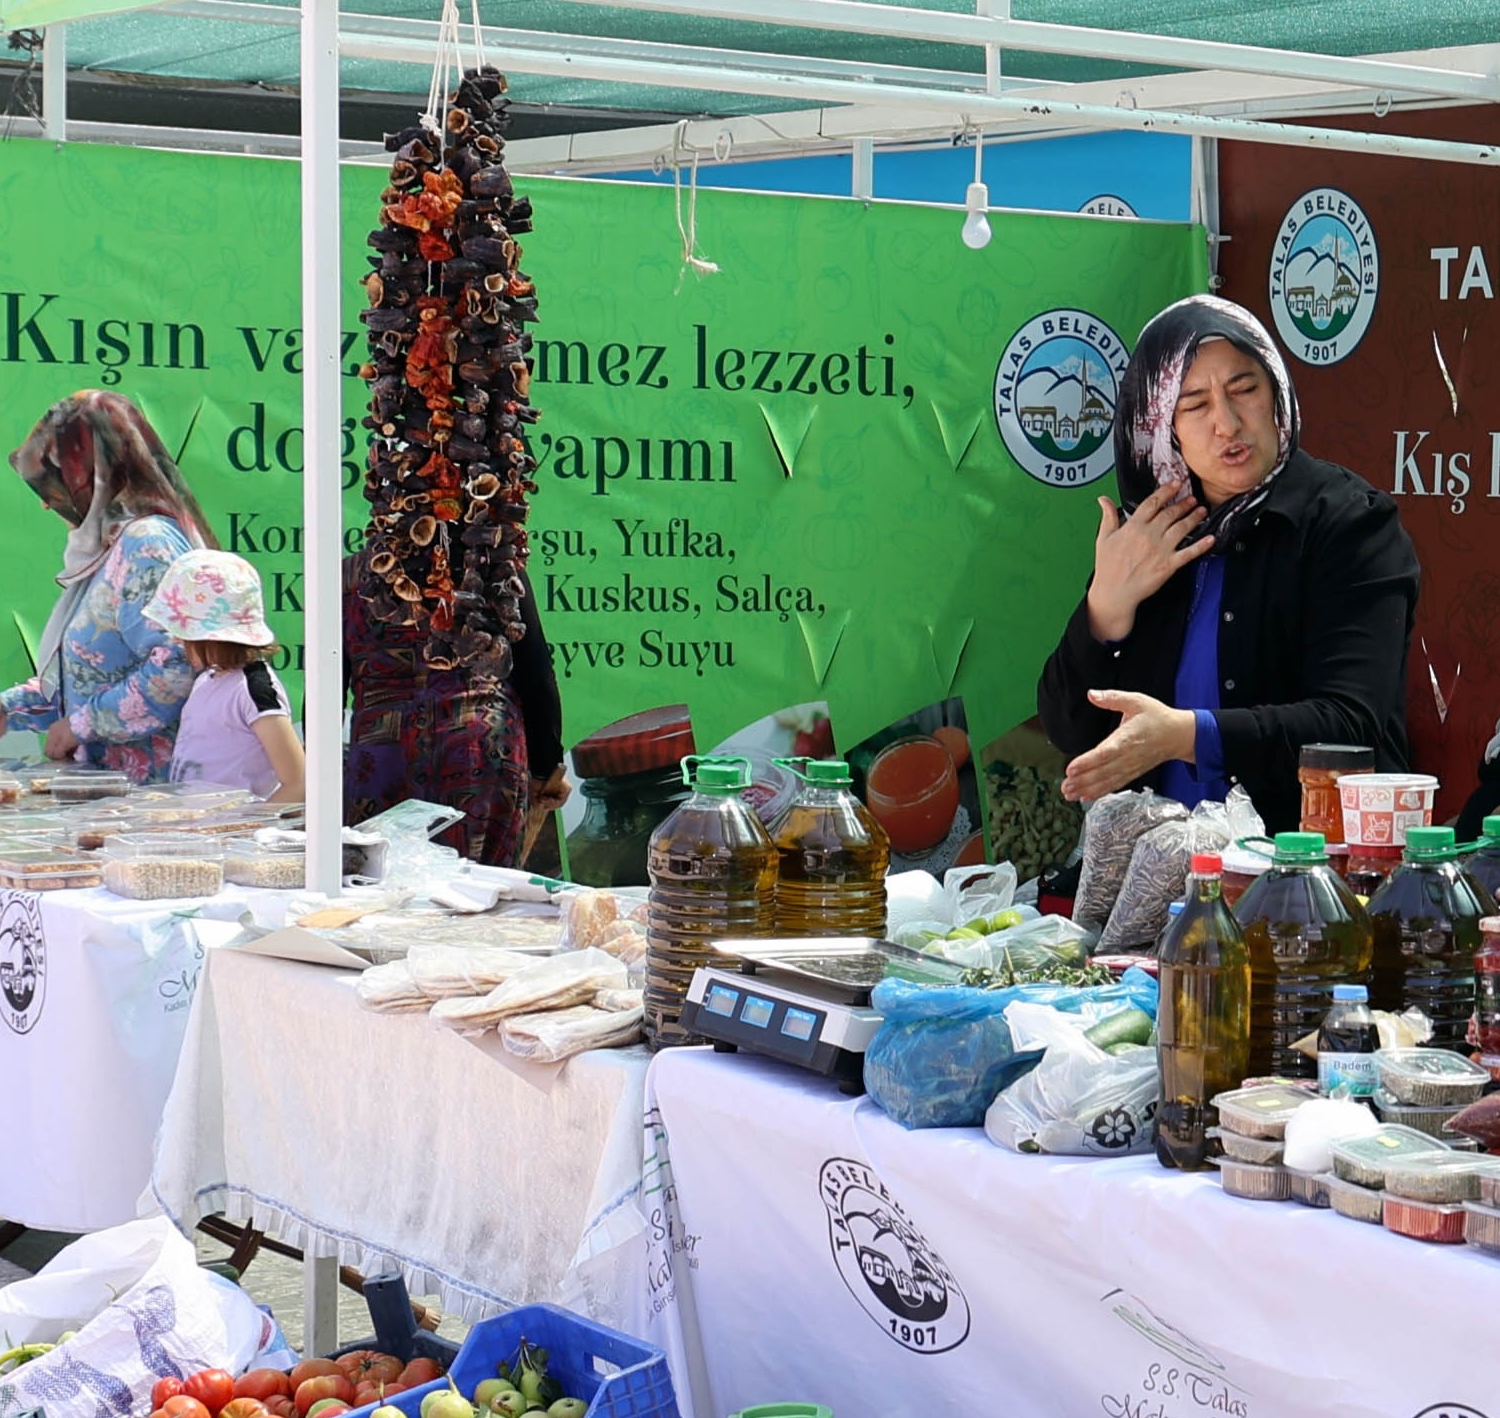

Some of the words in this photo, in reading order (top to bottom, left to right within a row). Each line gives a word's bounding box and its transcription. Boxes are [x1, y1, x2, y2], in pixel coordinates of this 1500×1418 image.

[1271, 217, 1298, 299] TALAS
[1303, 195, 1377, 295] BELEDİYESİ
[0, 291, 210, 385] Kışın
[692, 324, 916, 410] lezzeti,
[999, 334, 1032, 419] TALAS
[1043, 316, 1130, 373] BELEDİY
[1303, 341, 1339, 362] 1907
[1043, 461, 1088, 480] 1907
[1390, 430, 1472, 515] Kış
[612, 518, 737, 562] Yufka,
[544, 573, 701, 618] Kuskus,
[715, 573, 826, 623] Salça,
[638, 629, 736, 677] Suyu
[1333, 1060, 1372, 1071] Badem
[889, 1319, 937, 1346] 1907
[1184, 1372, 1248, 1418] Talas
